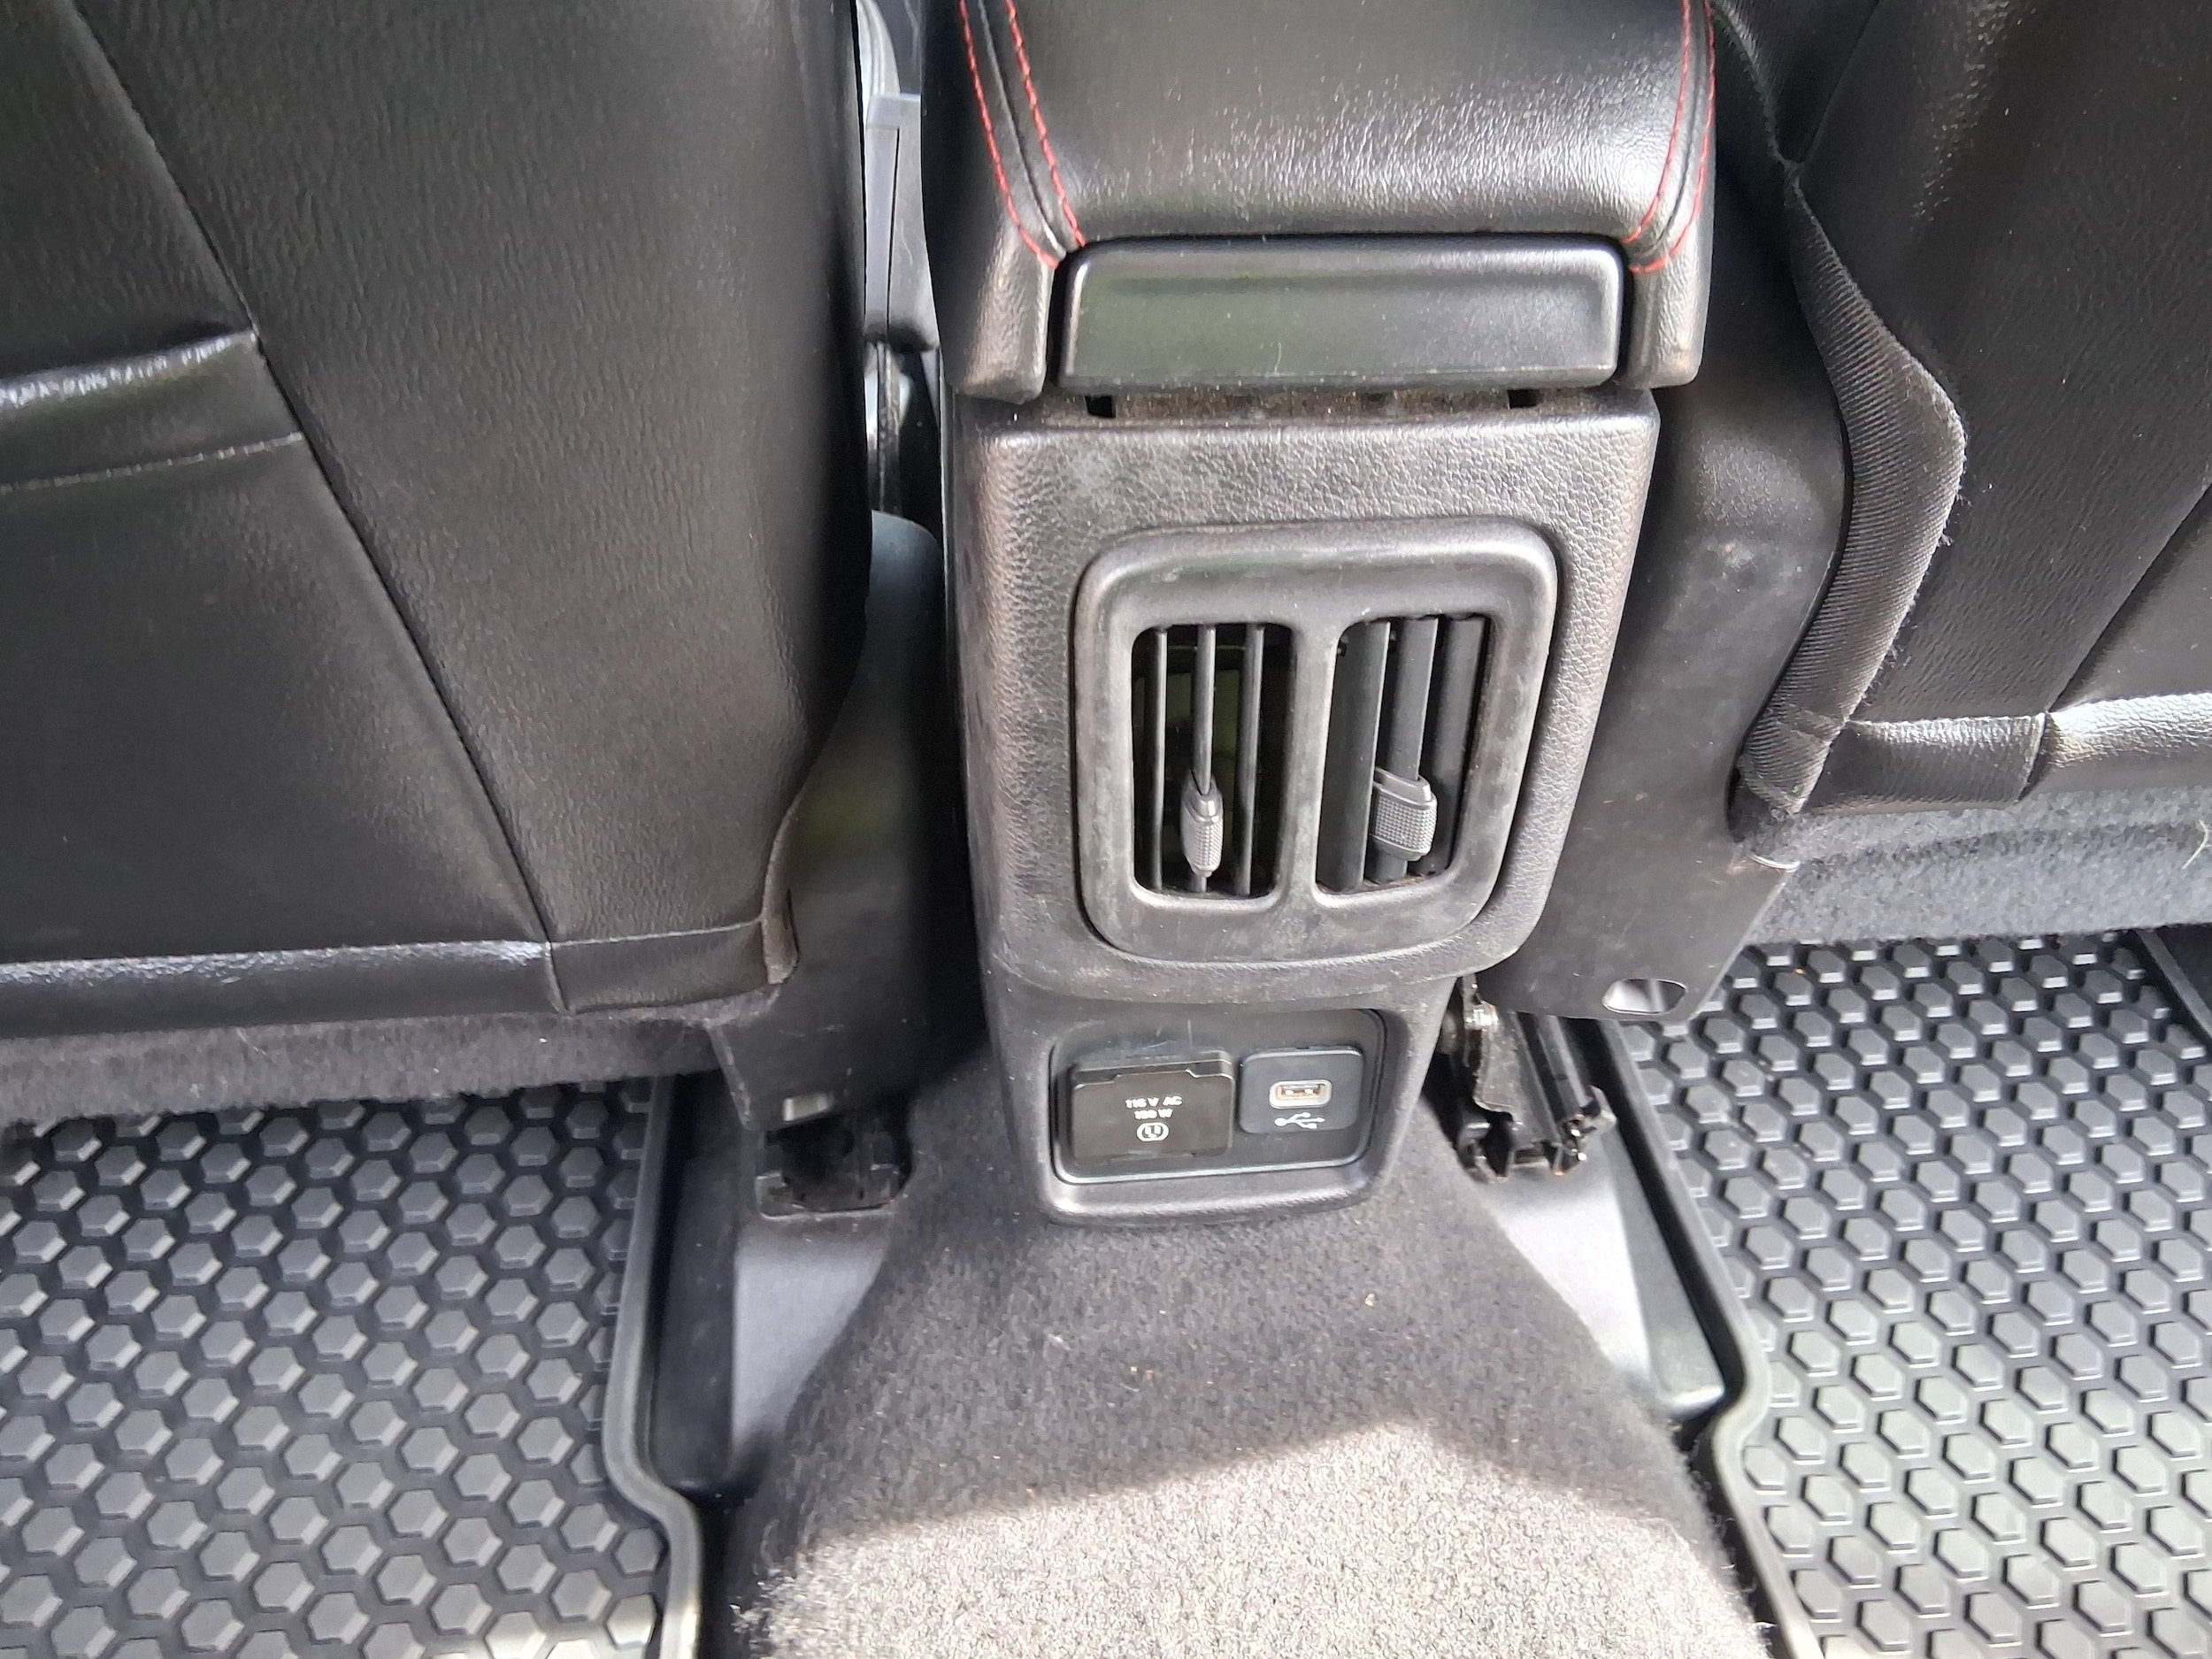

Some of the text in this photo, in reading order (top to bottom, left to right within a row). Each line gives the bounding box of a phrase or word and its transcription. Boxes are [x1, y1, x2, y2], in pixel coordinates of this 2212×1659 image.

[1148, 1097, 1159, 1107] V
[1163, 1096, 1182, 1105] AC
[1158, 1109, 1172, 1118] W
